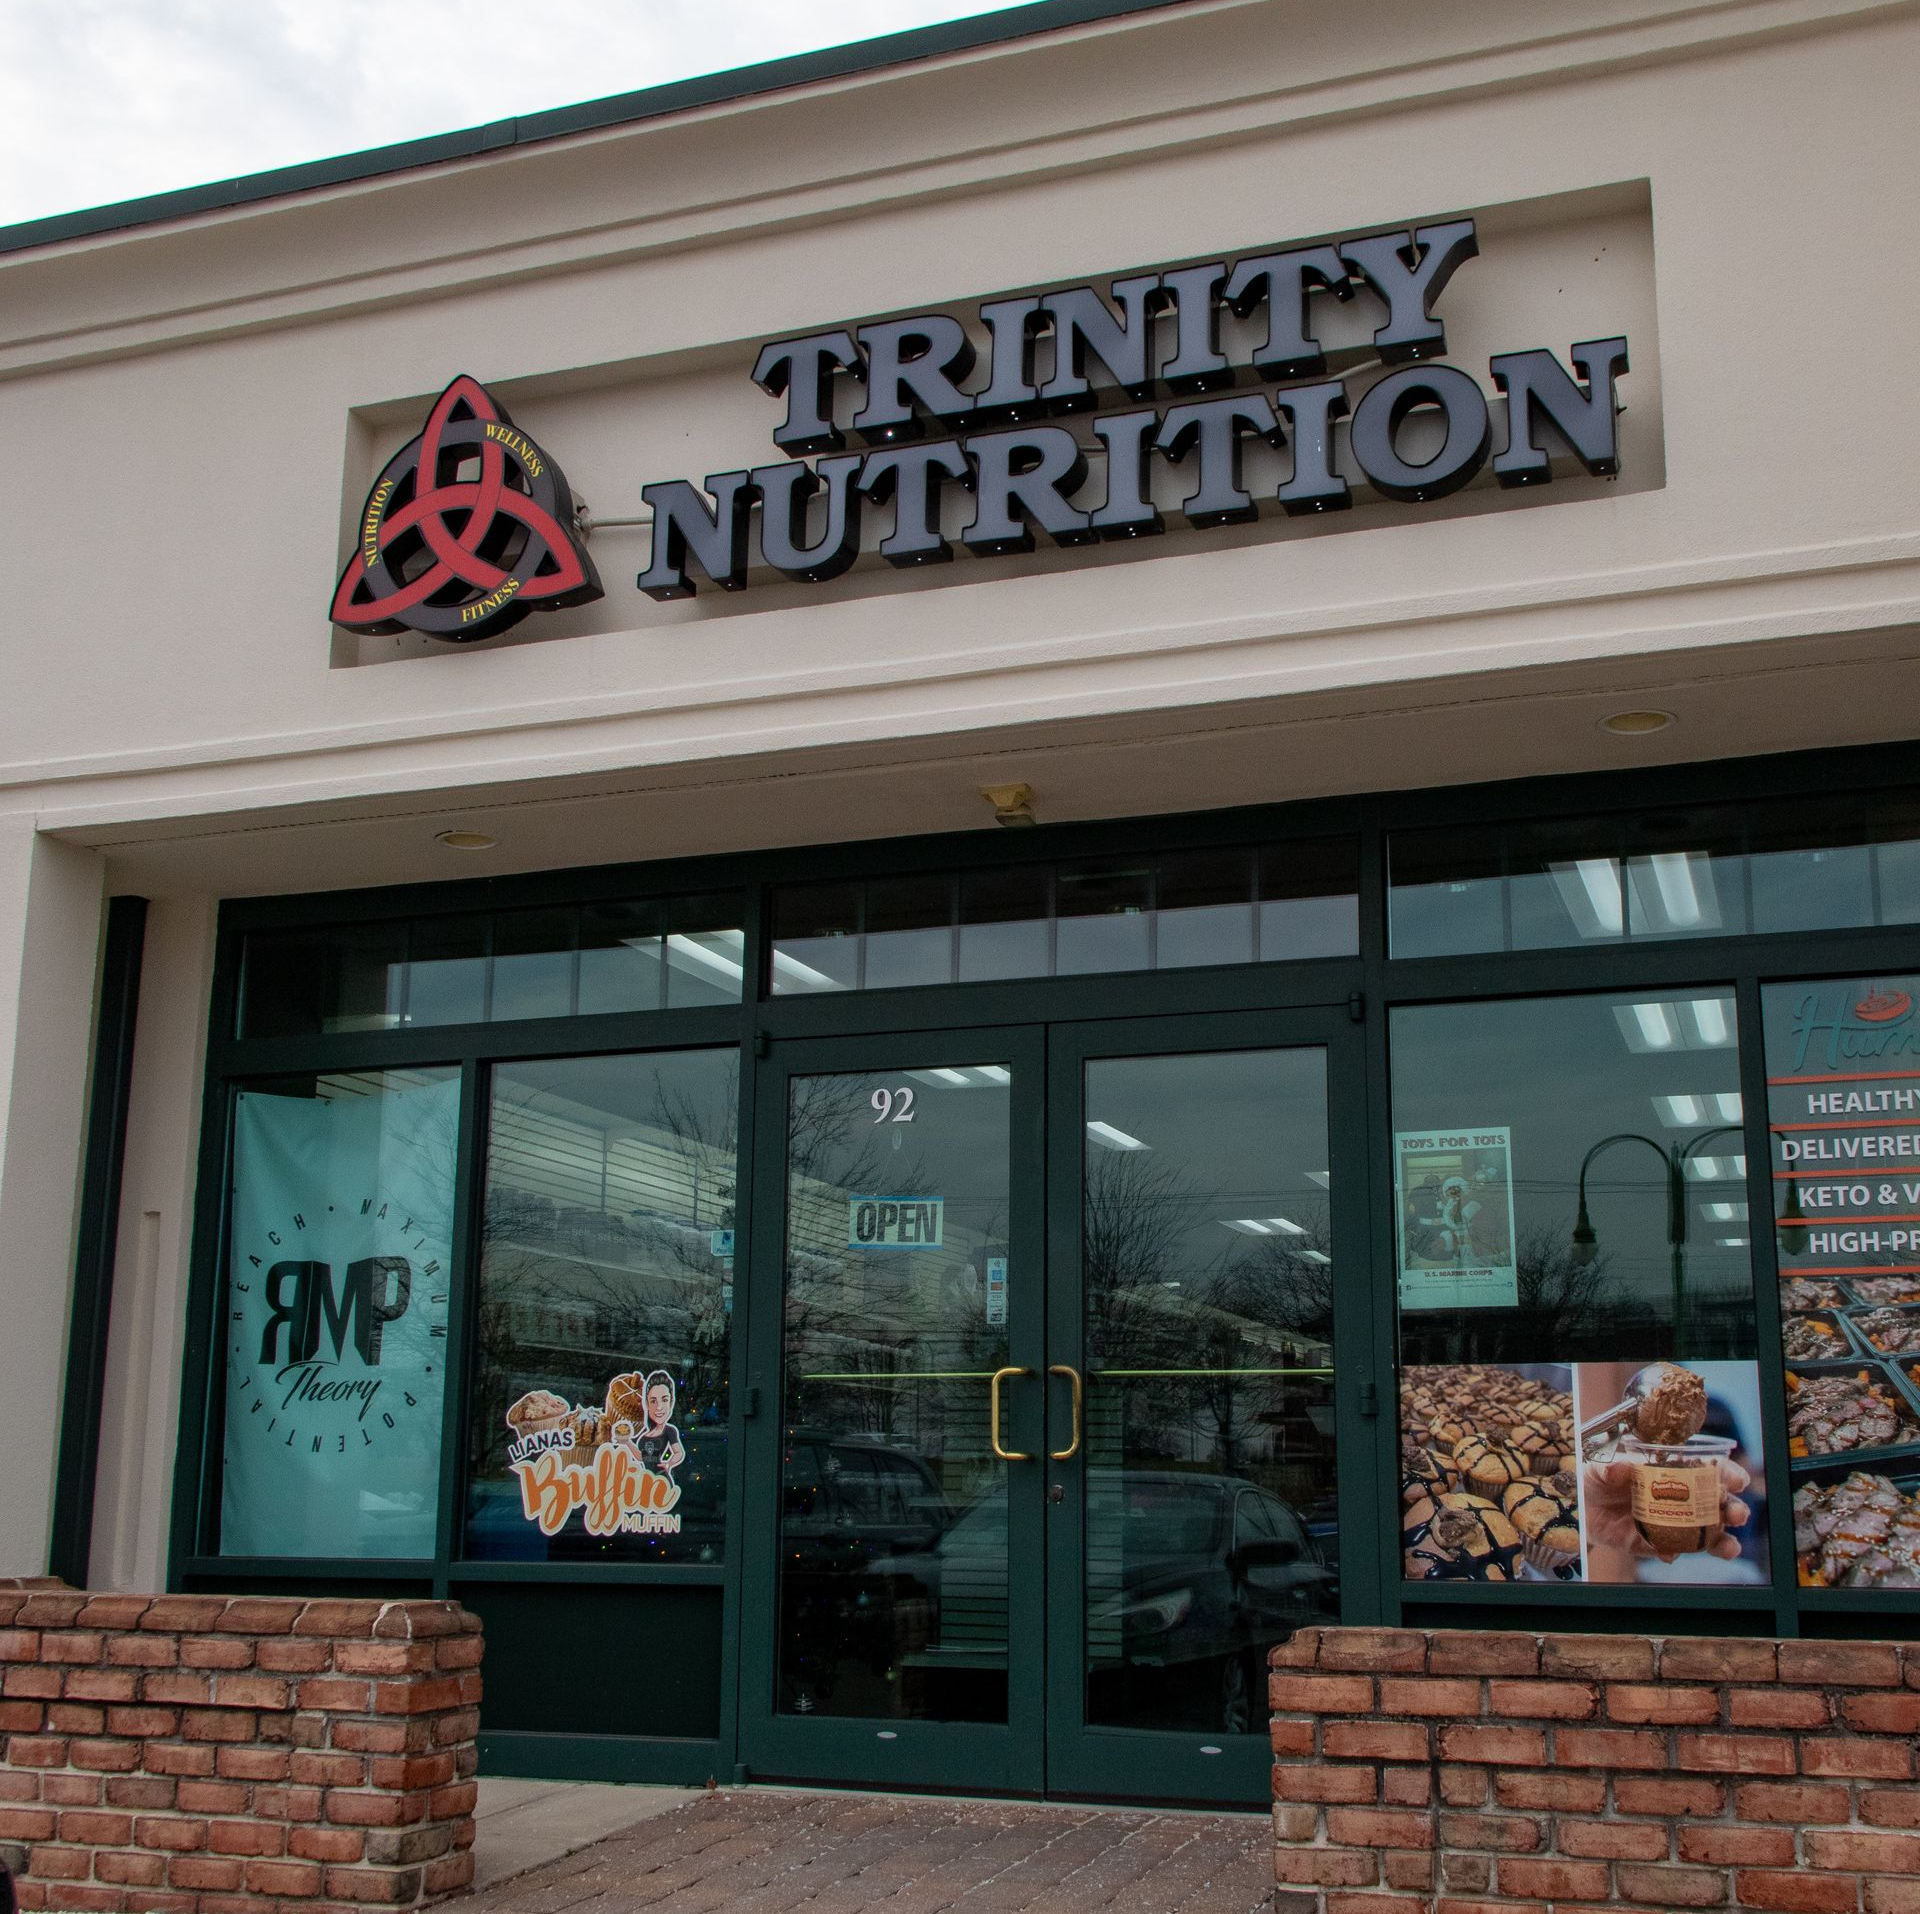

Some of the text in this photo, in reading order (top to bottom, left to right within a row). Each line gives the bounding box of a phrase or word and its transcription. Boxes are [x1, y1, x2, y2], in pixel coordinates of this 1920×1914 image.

[751, 218, 1477, 456] TRINITY
[485, 423, 544, 479] WELLNESS
[637, 336, 1629, 601] NUTRITION
[364, 478, 395, 569] NUTRITION
[461, 577, 521, 623] FITNESS
[871, 1086, 916, 1124] 92
[1401, 1134, 1506, 1149] TOYS FOR TOTS
[1781, 1135, 1920, 1161] DELIVERE
[1798, 1184, 1870, 1208] KETO
[1877, 1184, 1898, 1206] &
[856, 1202, 938, 1244] OPEN
[232, 1212, 306, 1322] REACH
[360, 1198, 448, 1339] MAXIMUM
[275, 1360, 383, 1423] Theory
[508, 1430, 574, 1462] LIANAS
[520, 1449, 677, 1531] Buffin
[622, 1514, 681, 1533] MUFFIN
